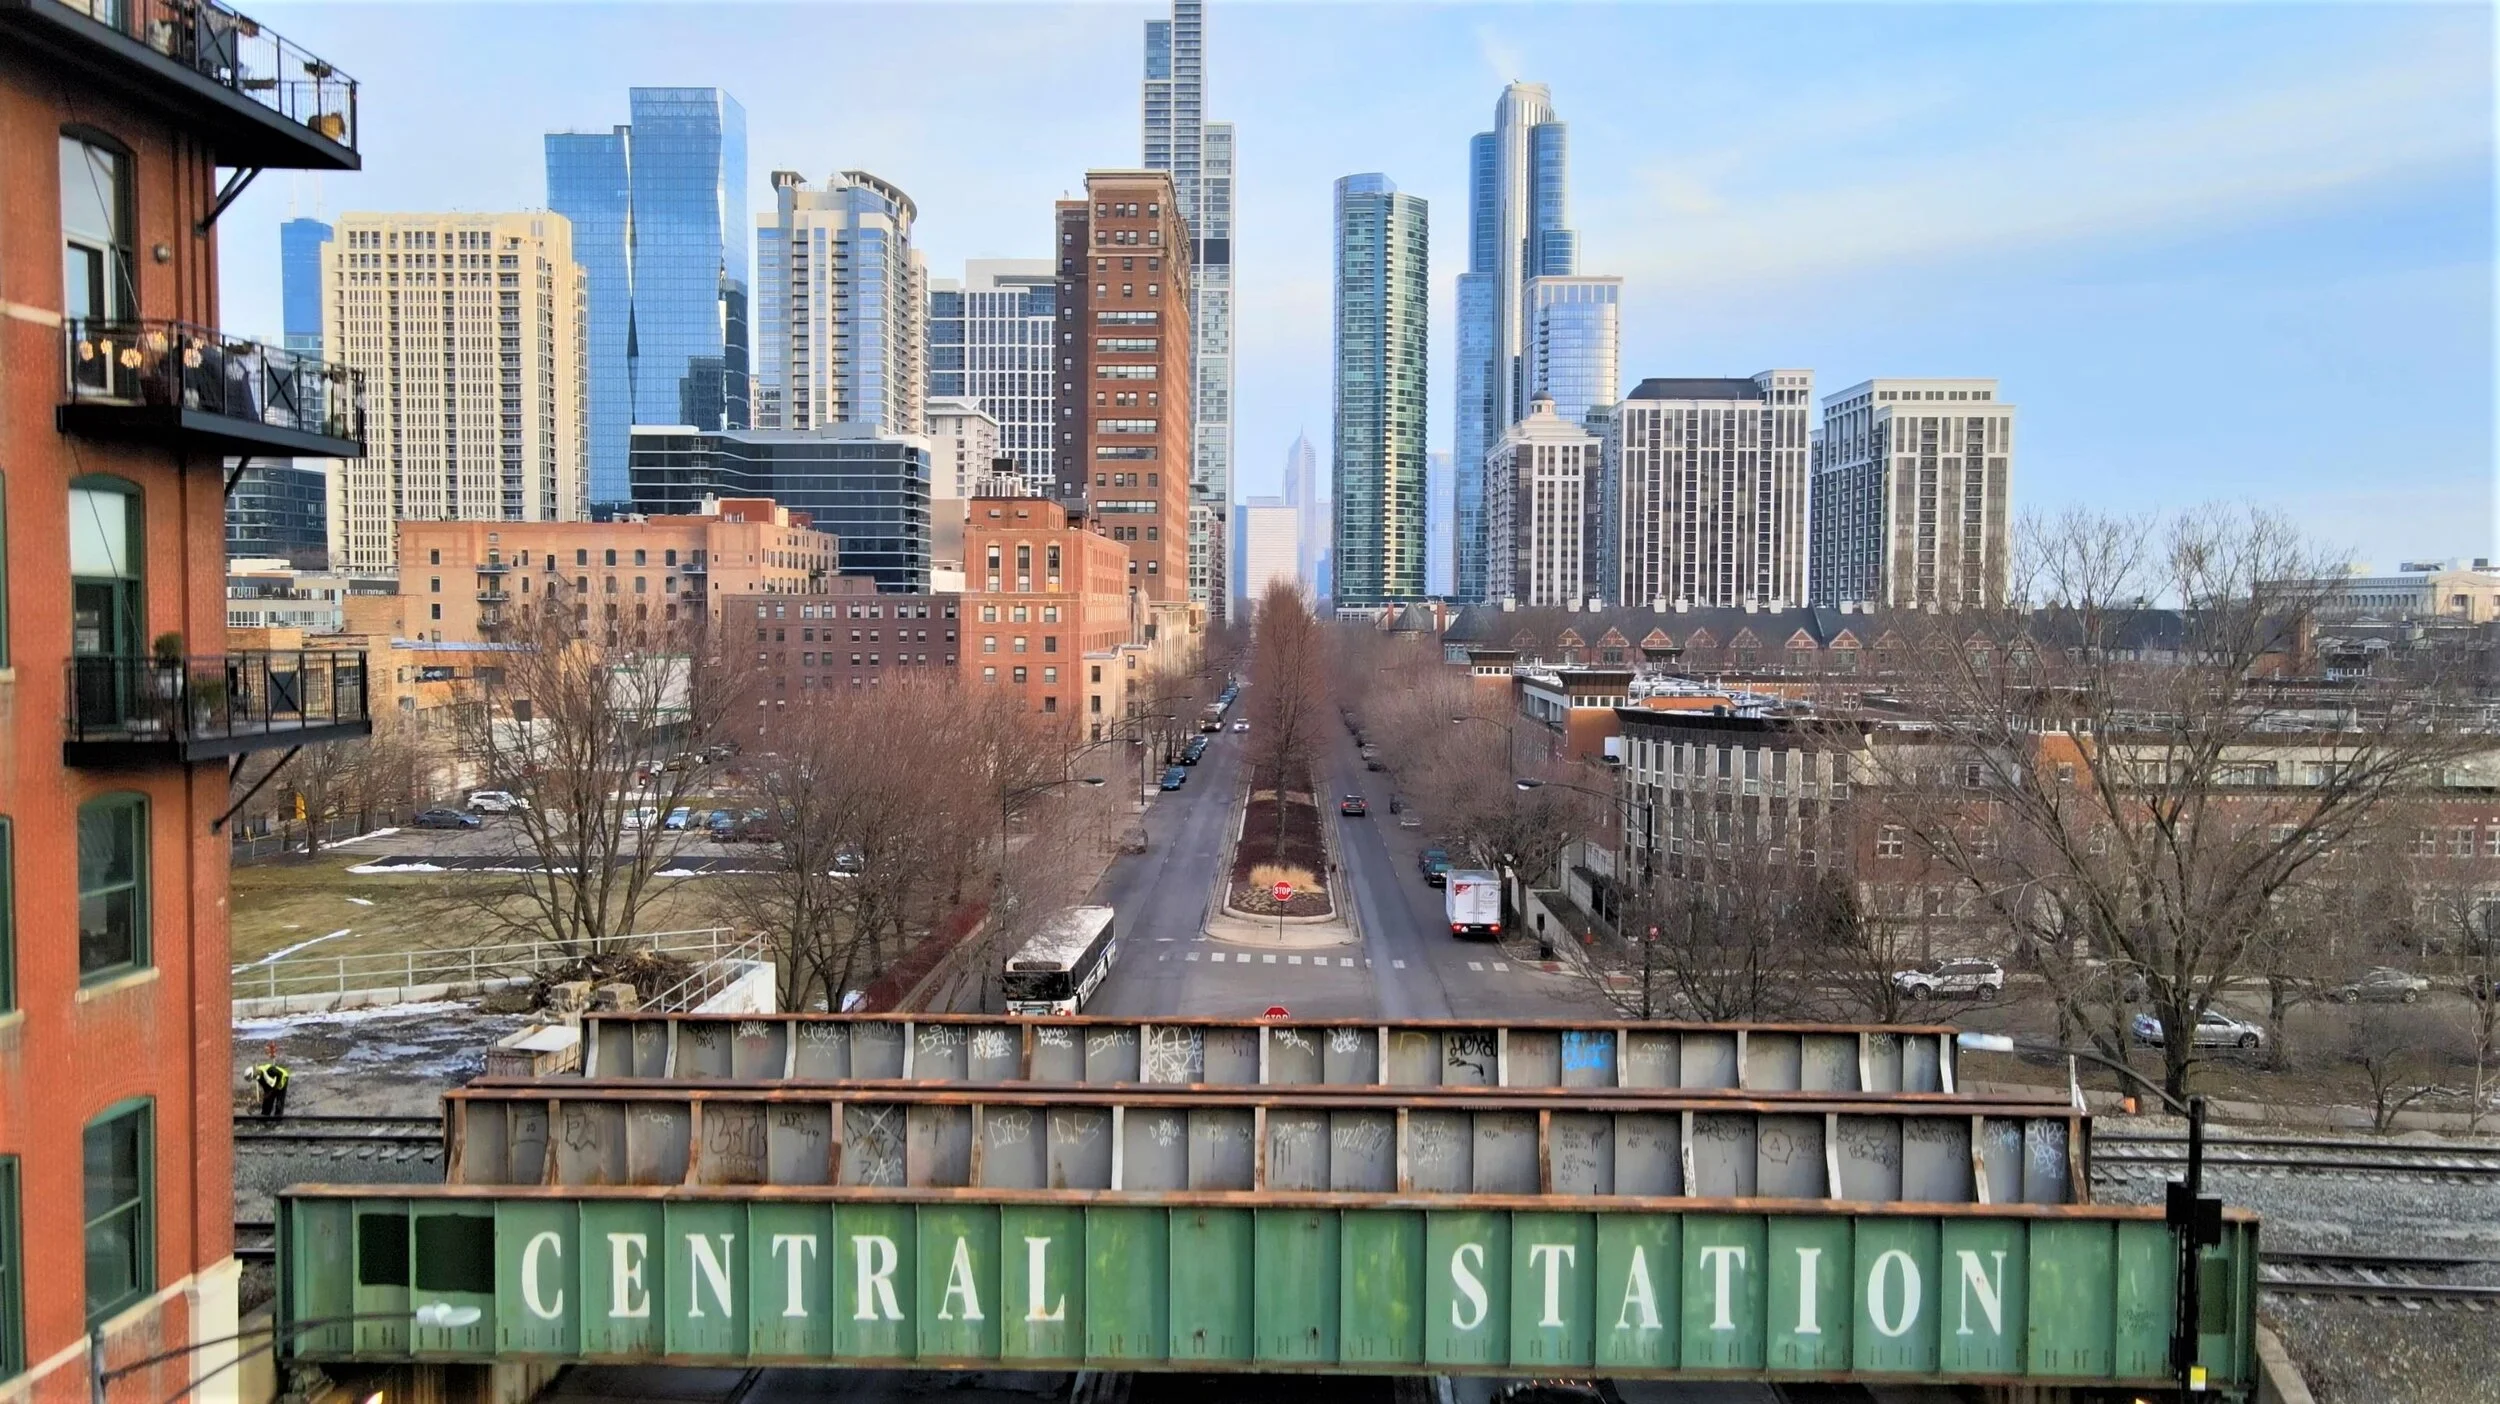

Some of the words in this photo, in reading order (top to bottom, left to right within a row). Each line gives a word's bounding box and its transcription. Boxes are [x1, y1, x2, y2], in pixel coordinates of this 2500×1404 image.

[1273, 886, 1291, 896] STOP
[521, 1231, 1066, 1321] CENTRAL
[1451, 1242, 2007, 1338] STATION
